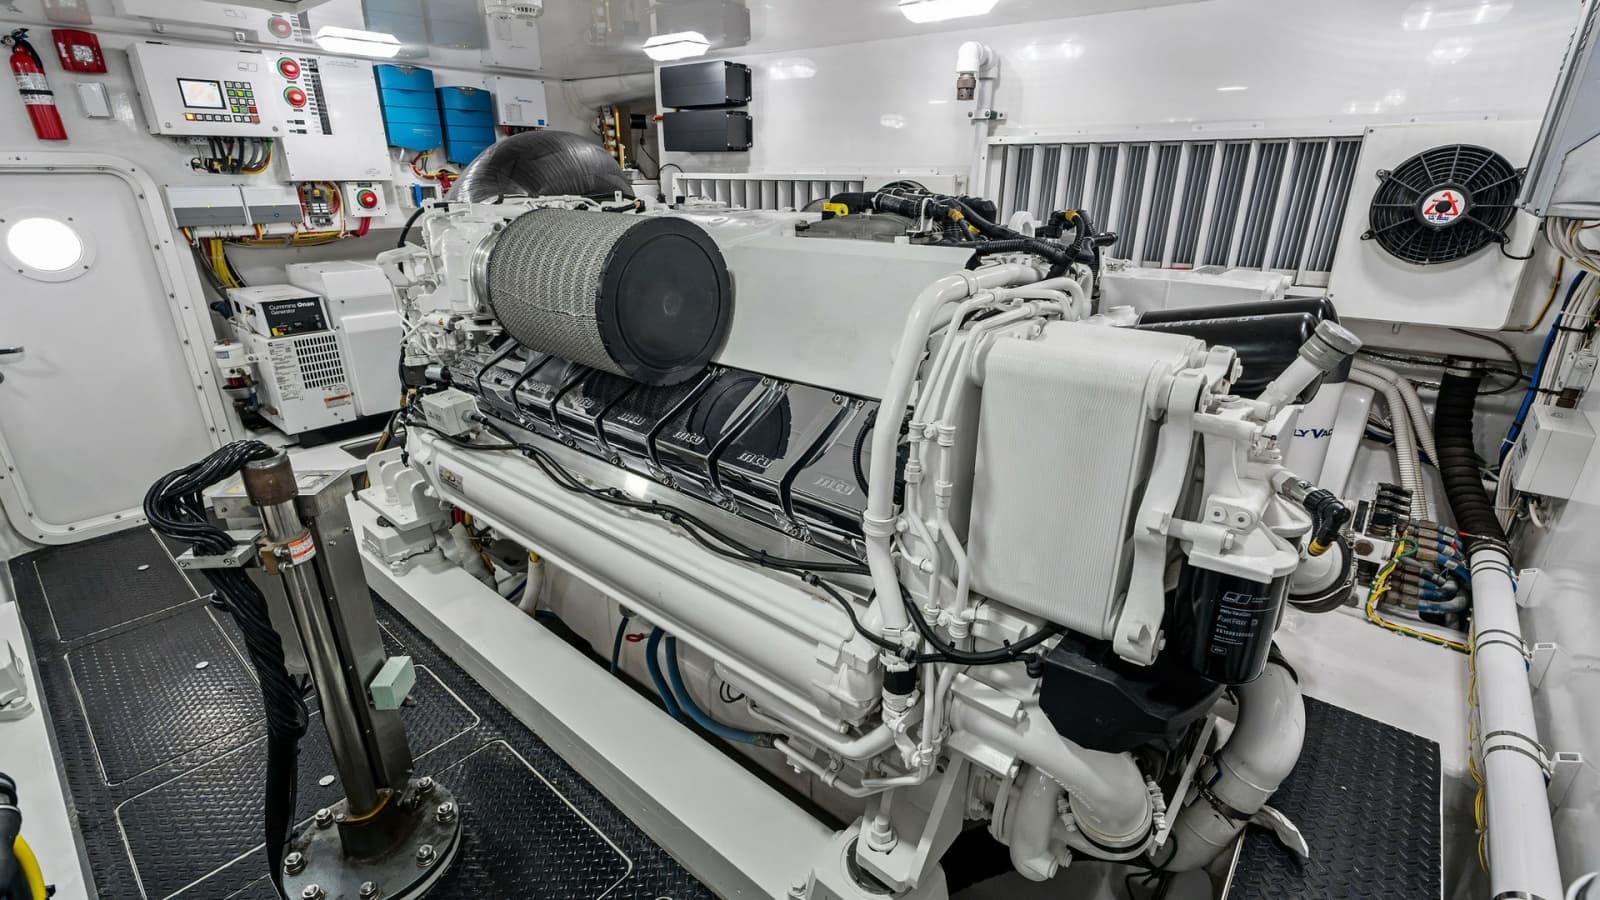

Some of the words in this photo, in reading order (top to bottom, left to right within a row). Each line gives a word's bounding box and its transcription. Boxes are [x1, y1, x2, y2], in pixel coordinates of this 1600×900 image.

[616, 412, 647, 426] mtu
[672, 430, 706, 446] mtu
[736, 451, 773, 469] mtu
[812, 477, 857, 496] mtu
[1217, 614, 1231, 624] Fuel
[1232, 618, 1248, 626] Filter
